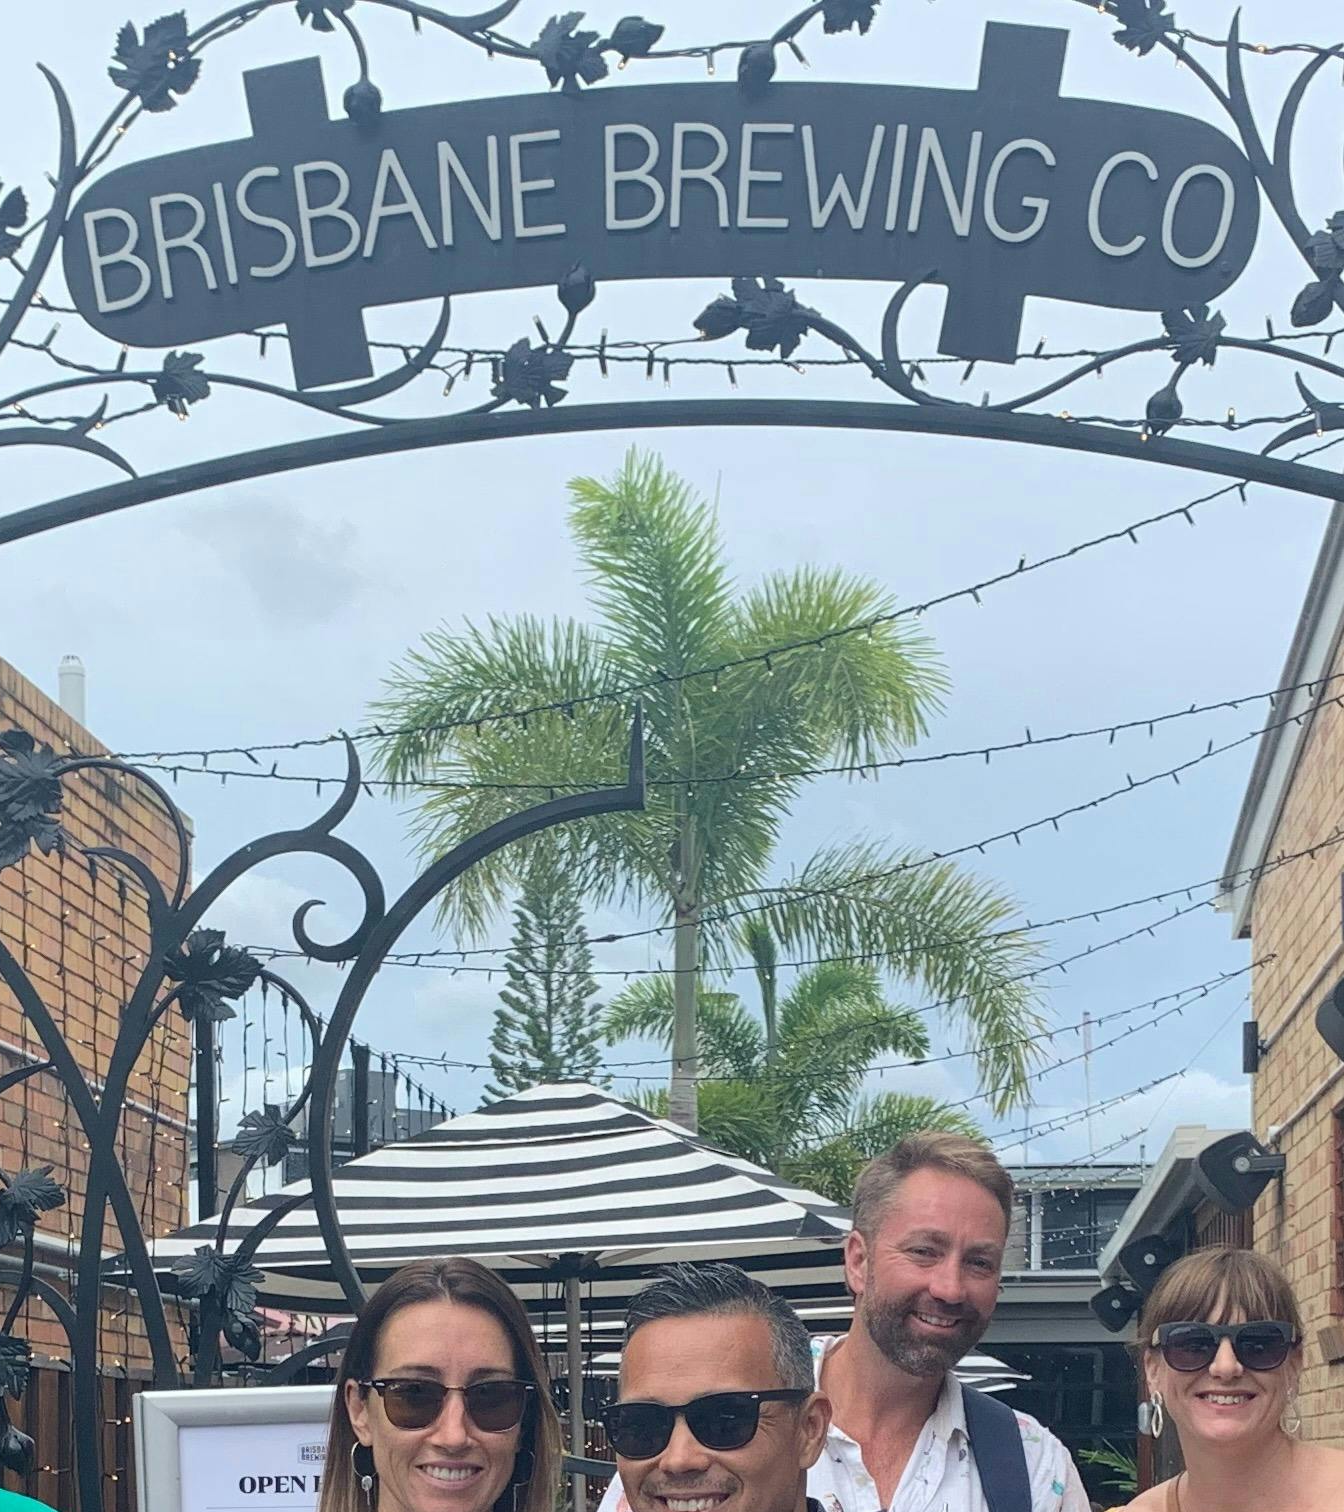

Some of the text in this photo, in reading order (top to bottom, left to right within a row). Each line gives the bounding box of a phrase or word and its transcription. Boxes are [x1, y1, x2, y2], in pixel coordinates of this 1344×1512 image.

[84, 122, 1237, 315] BRISBANE BREWING CO
[238, 1475, 307, 1494] OPEN
